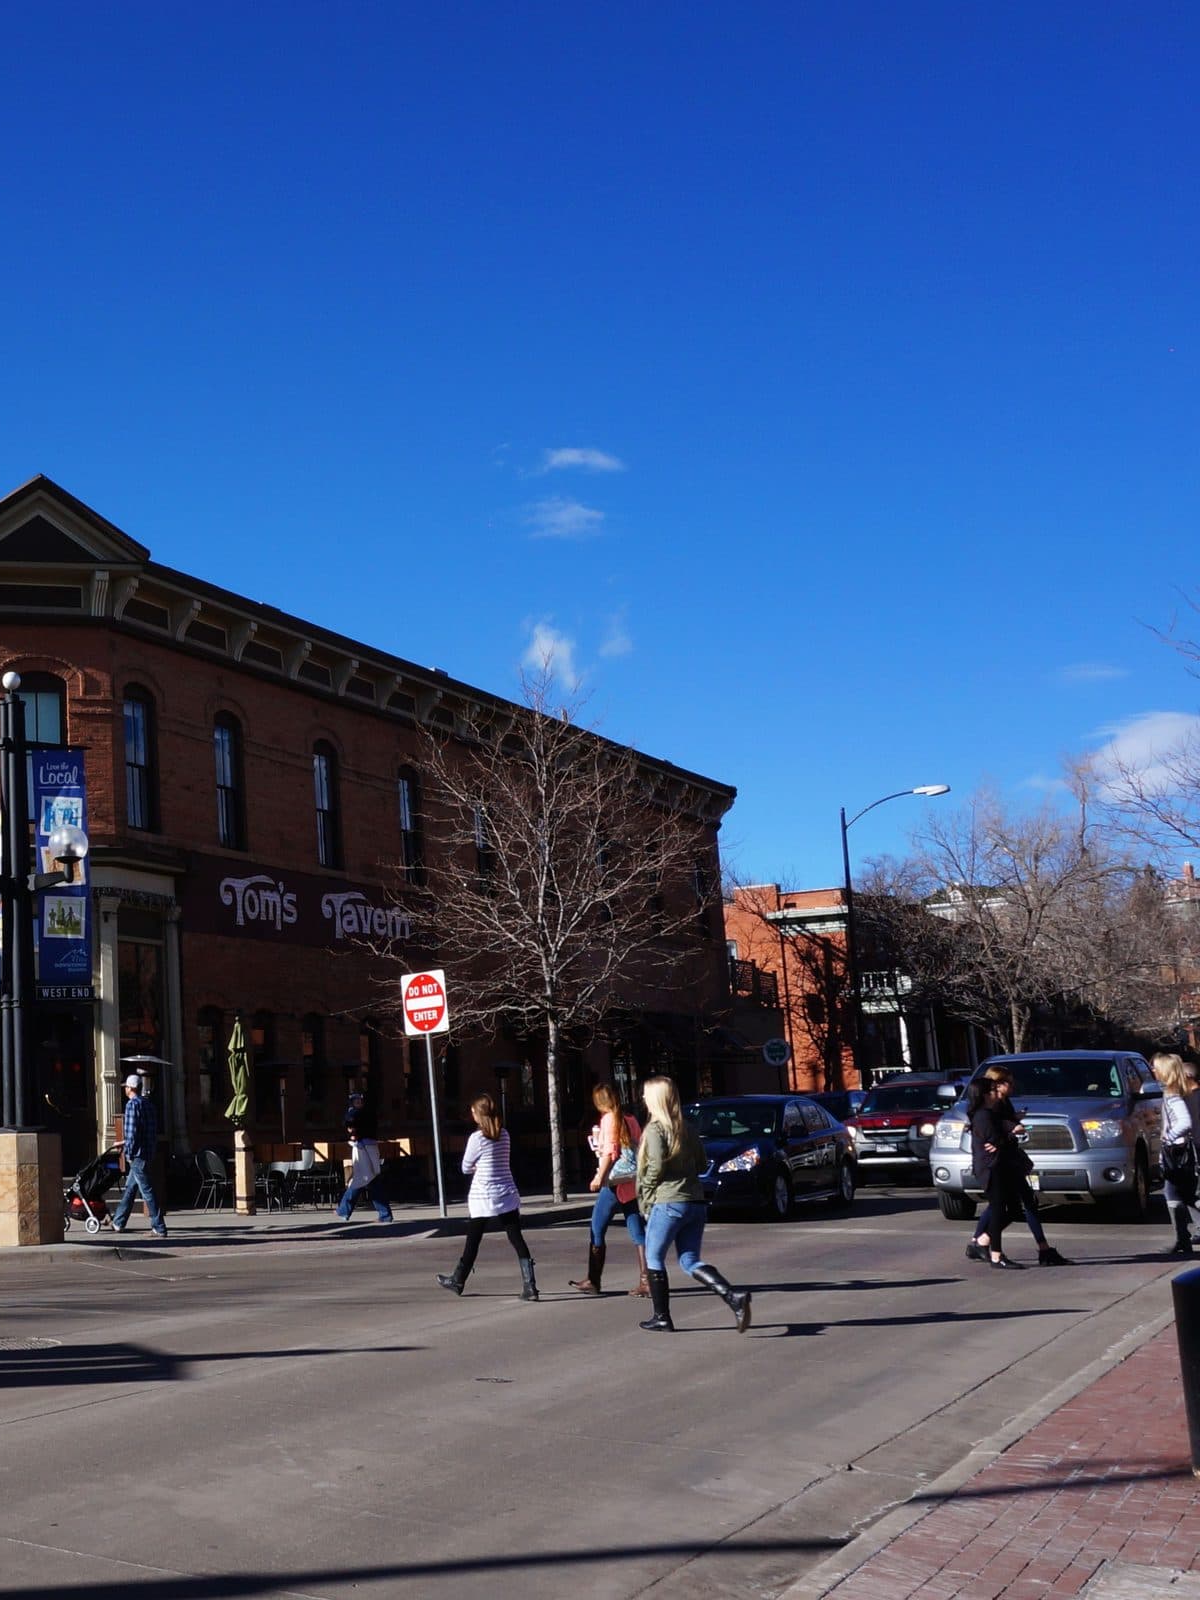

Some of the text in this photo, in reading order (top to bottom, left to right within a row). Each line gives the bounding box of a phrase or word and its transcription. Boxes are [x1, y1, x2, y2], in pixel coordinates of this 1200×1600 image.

[60, 761, 69, 770] the
[39, 766, 79, 785] Local
[219, 875, 410, 939] Tom's Tavern
[42, 987, 90, 998] WEST END
[408, 983, 438, 997] DO NOT
[413, 1009, 438, 1023] ENTER
